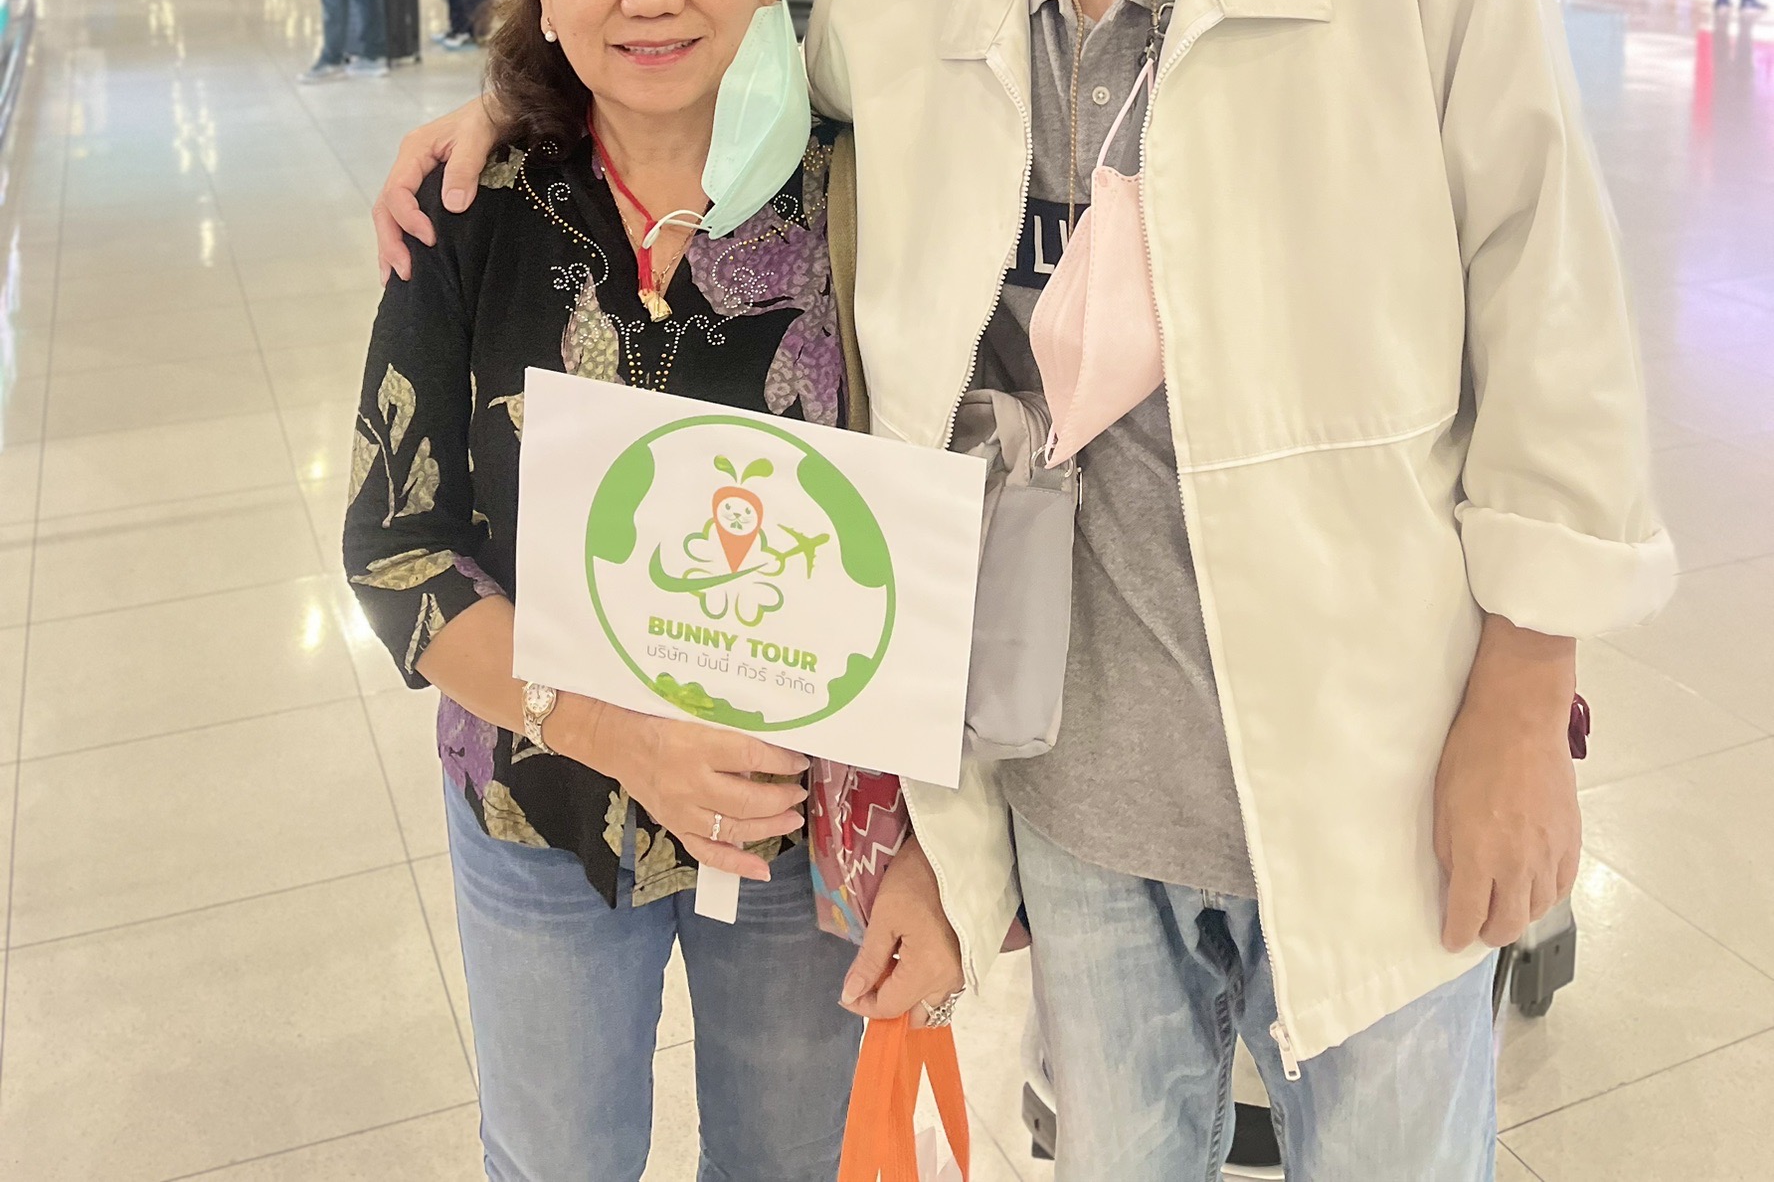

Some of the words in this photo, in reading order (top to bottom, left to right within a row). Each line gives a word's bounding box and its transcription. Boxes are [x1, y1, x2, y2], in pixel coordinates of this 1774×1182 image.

[646, 644, 688, 663] บริษัท
[697, 652, 729, 673] บันนี่
[737, 662, 767, 682] ทัวร์
[775, 670, 815, 694] จำกัด
[648, 615, 738, 652] BUNNY
[746, 637, 818, 673] TOUR
